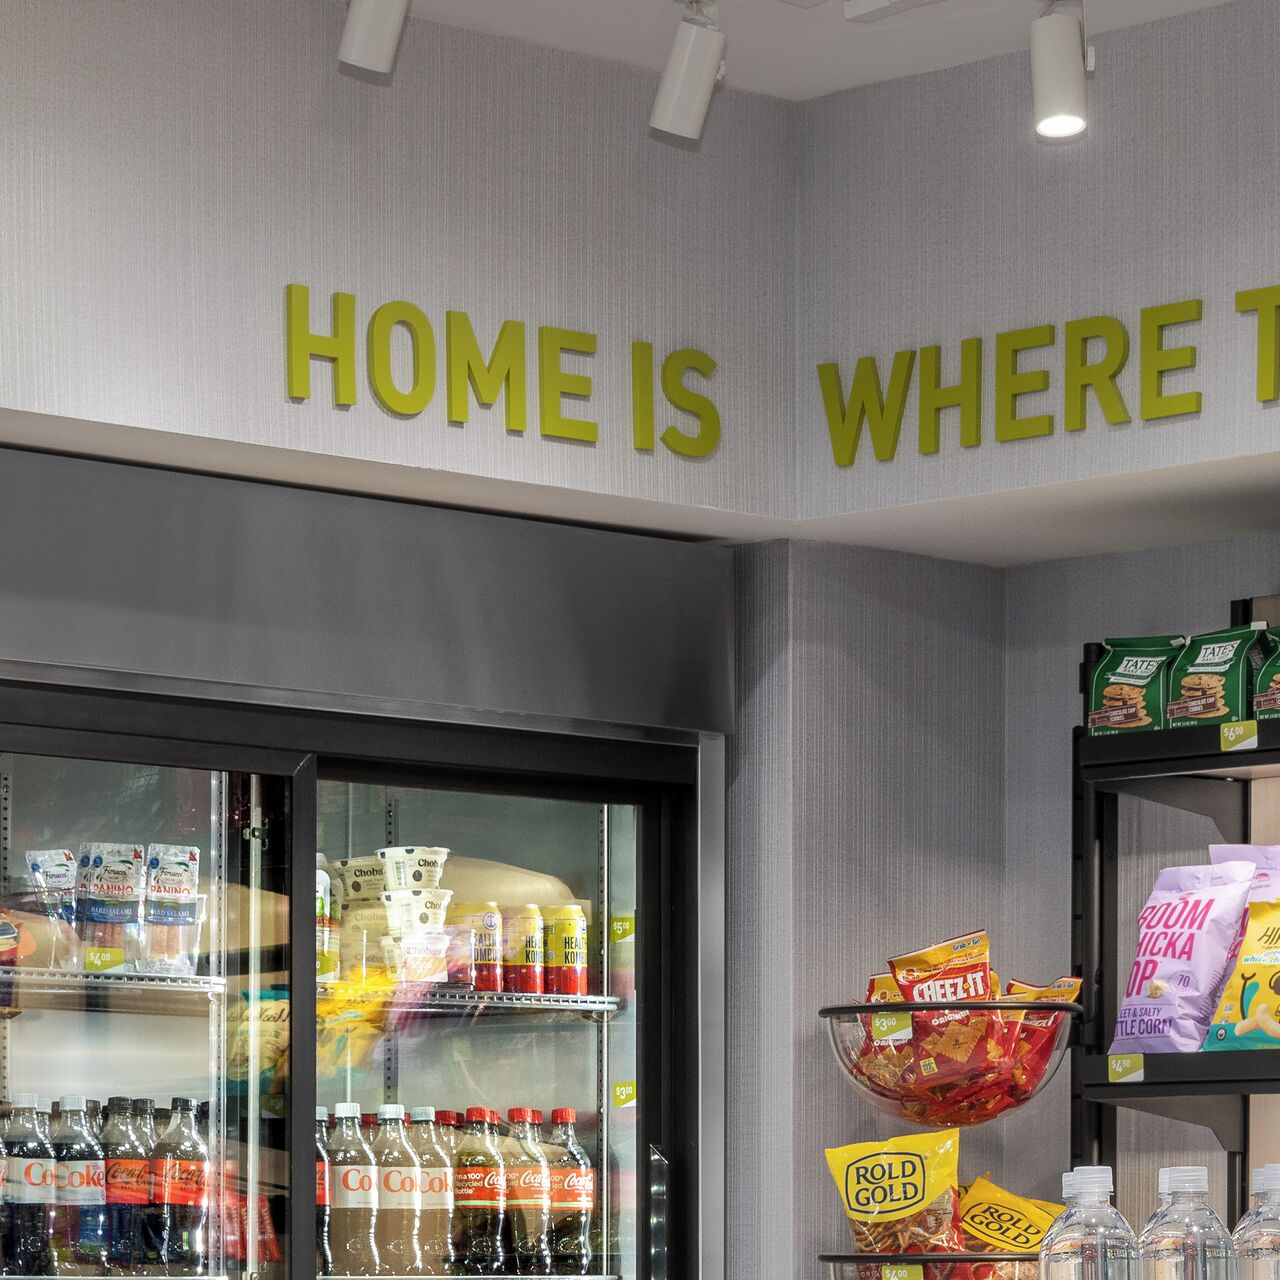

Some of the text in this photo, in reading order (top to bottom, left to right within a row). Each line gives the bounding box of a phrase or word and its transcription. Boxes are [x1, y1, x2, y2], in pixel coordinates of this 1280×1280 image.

[286, 283, 720, 457] HOME IS
[815, 296, 1205, 469] WHERE
[1202, 643, 1239, 656] TATE'S
[1138, 1007, 1162, 1017] SALTY
[1138, 1019, 1172, 1035] CORN
[855, 1160, 918, 1185] ROLD
[855, 1179, 919, 1207] GOLD
[969, 1211, 1030, 1246] GOLD
[983, 1203, 1042, 1237] ROLD
